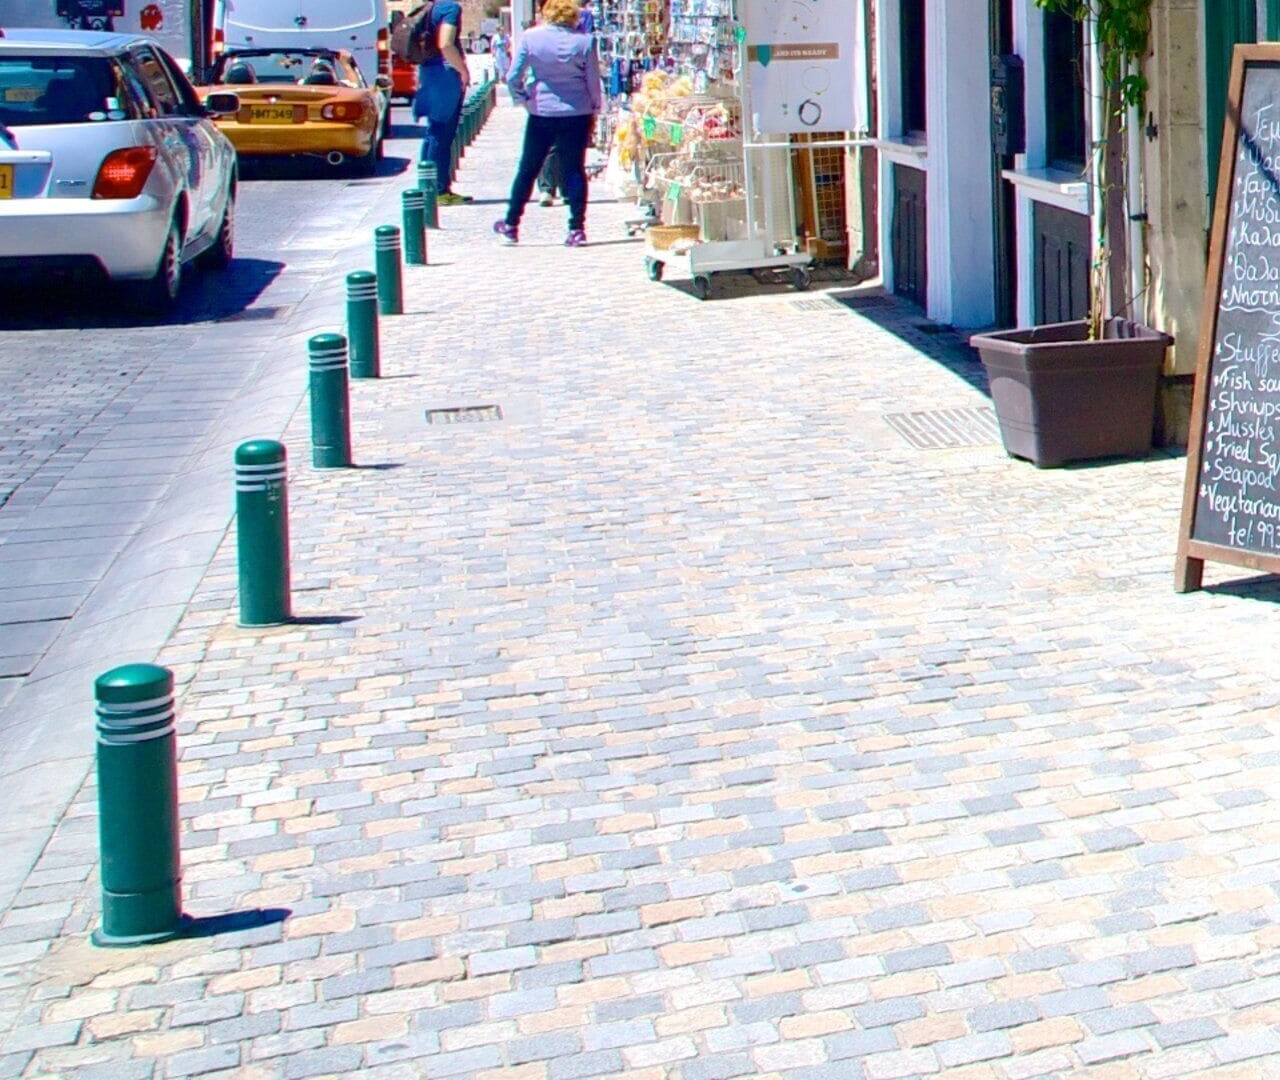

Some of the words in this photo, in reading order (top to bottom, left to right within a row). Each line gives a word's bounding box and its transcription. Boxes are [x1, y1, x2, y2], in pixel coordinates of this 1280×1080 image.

[1219, 365, 1253, 391] Fish
[1214, 431, 1253, 464] Fried
[1211, 457, 1277, 496] Seafood
